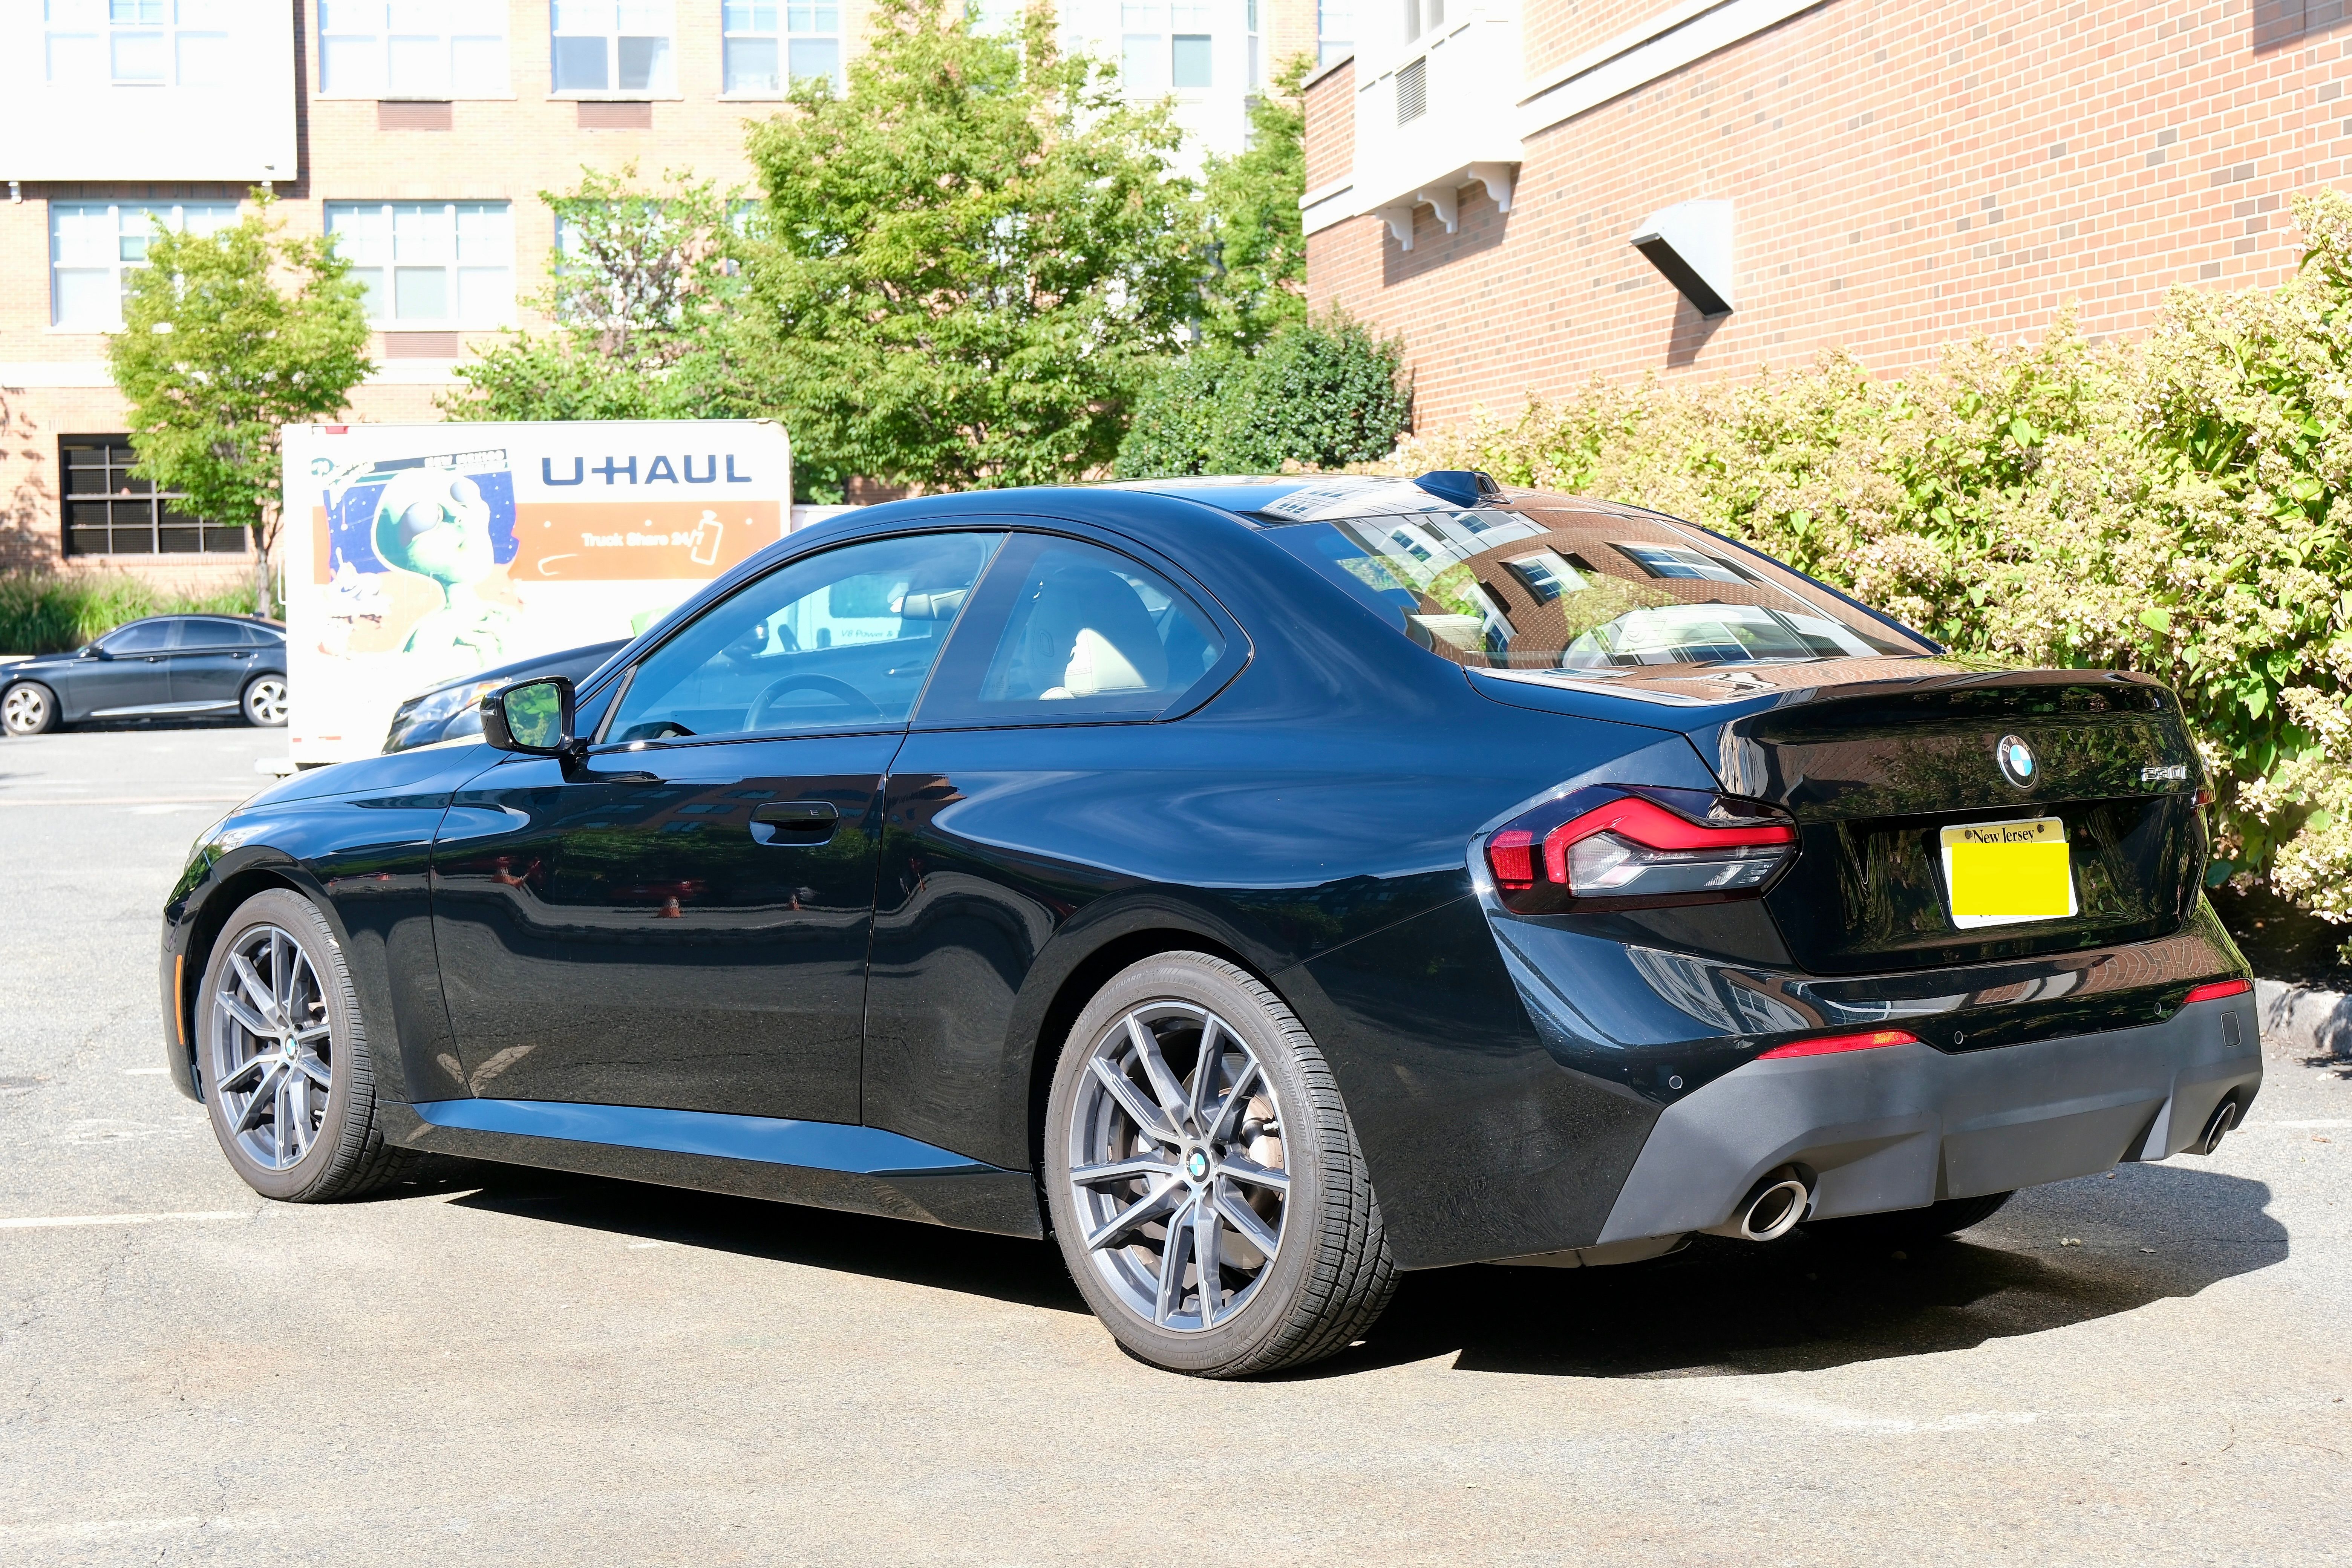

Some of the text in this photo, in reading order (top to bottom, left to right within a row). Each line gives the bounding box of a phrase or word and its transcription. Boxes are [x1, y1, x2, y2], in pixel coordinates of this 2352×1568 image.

[424, 455, 453, 467] NEW
[456, 450, 504, 465] MEXICO
[542, 454, 752, 486] U-HAUL
[581, 529, 704, 548] Truck Share 24/7
[2002, 737, 2029, 753] BMW
[1972, 827, 2034, 843] New Jersey
[1282, 1070, 1308, 1145] BRIDGESTONE
[1186, 1148, 1194, 1180] BMW
